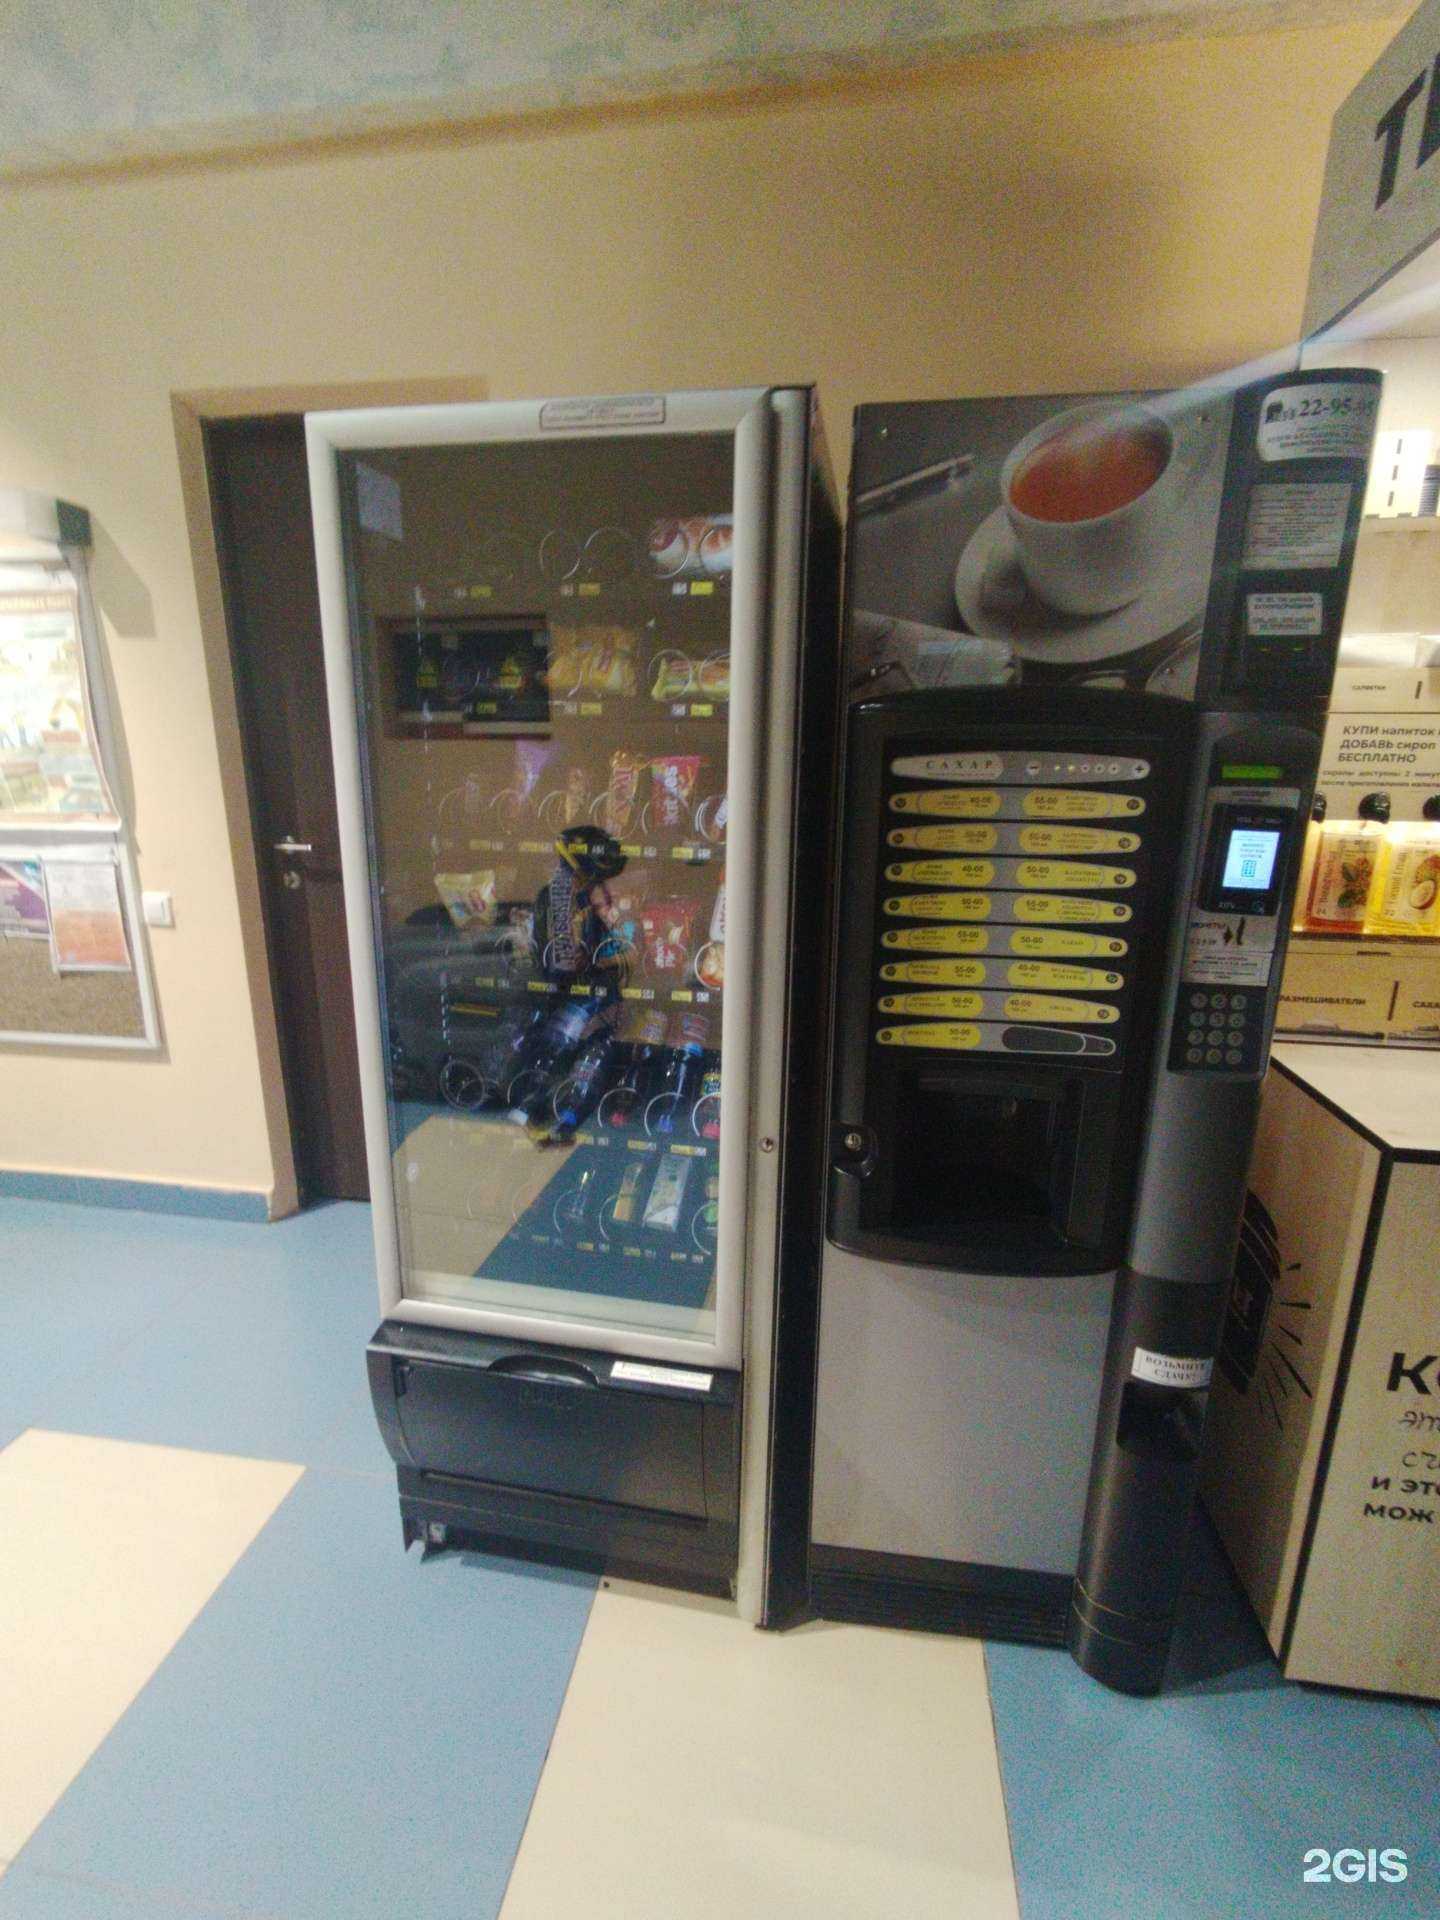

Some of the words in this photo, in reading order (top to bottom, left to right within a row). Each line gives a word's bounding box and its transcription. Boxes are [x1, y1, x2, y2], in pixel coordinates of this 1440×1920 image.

[1343, 725, 1379, 736] КУПИ
[1382, 728, 1435, 736] напиток
[1339, 739, 1394, 749] ДОБАВЬ
[1397, 742, 1436, 751] сироп
[1338, 753, 1417, 763] БЕСПЛАТНО
[926, 760, 994, 769] САХАР
[1386, 1352, 1440, 1395] К
[1370, 1476, 1391, 1490] и
[1363, 1503, 1435, 1524] мож
